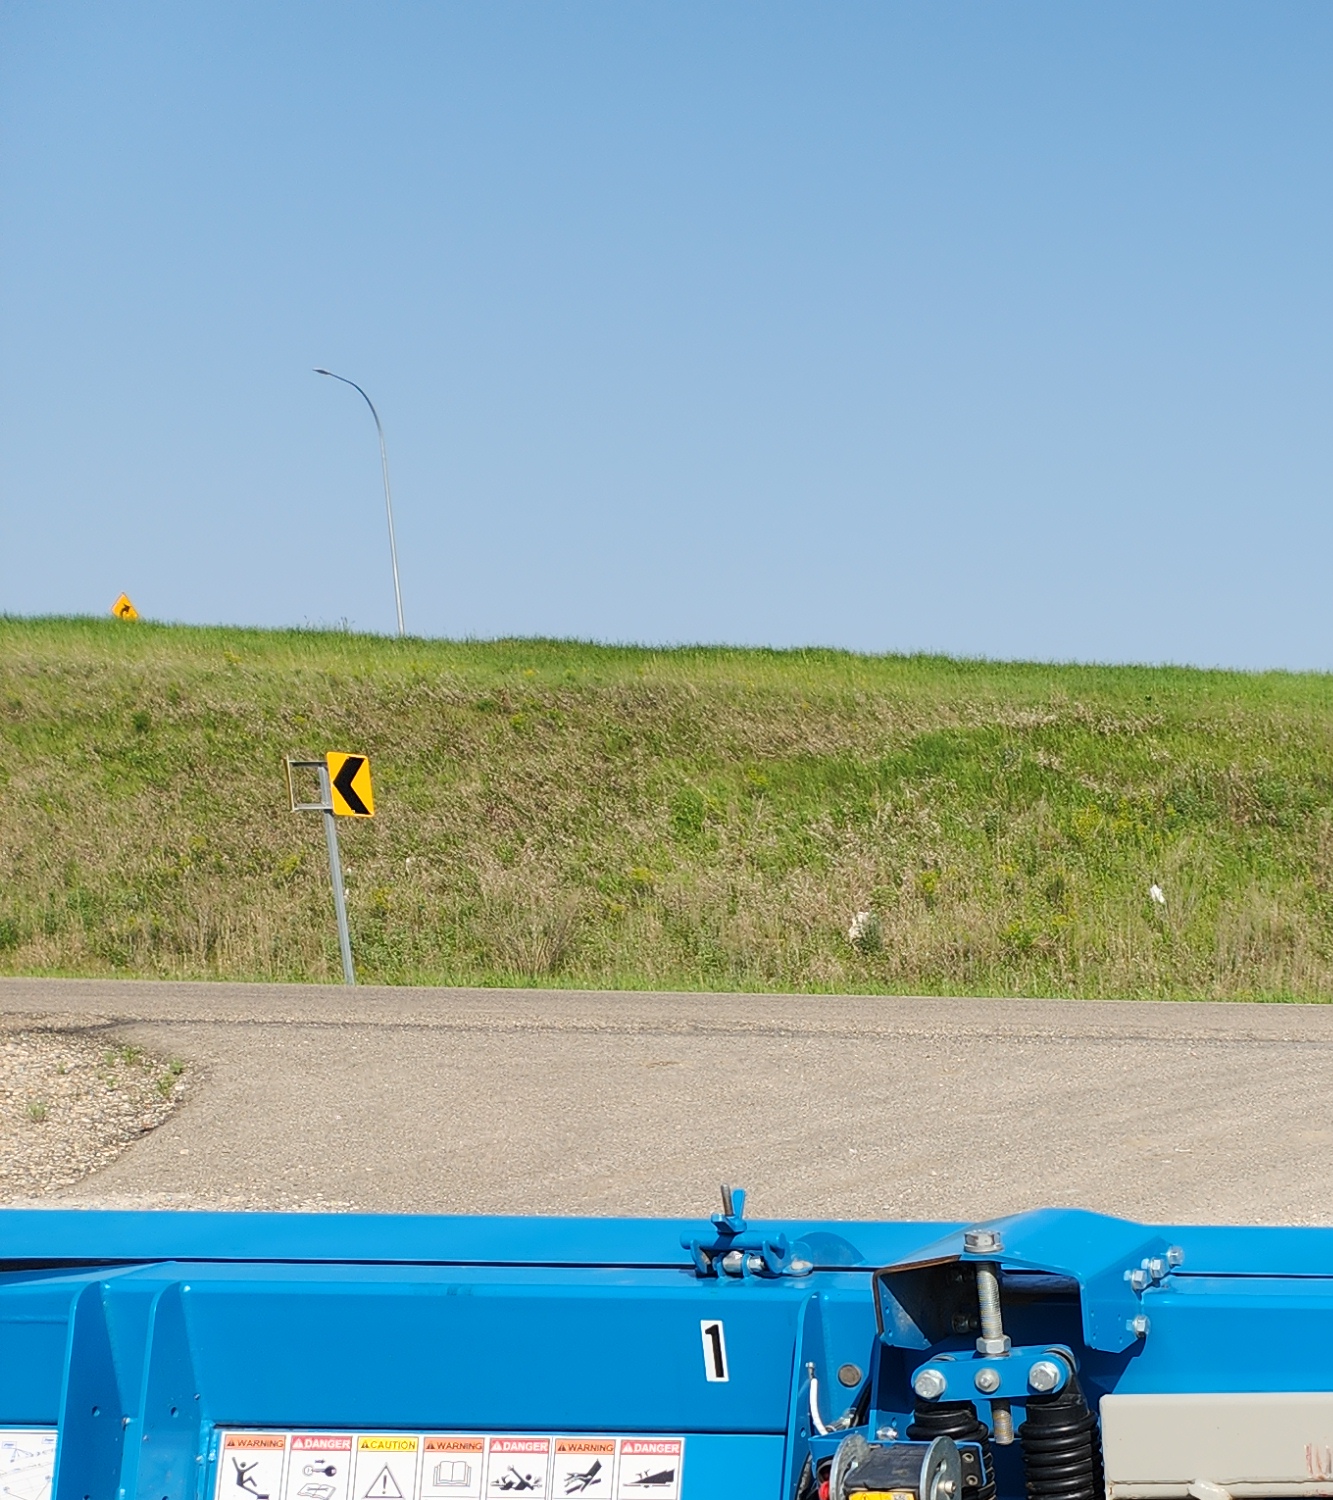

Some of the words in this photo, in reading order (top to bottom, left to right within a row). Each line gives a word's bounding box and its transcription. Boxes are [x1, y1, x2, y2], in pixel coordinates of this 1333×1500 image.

[705, 1324, 724, 1378] 1
[237, 1439, 284, 1448] WARNING
[304, 1438, 351, 1449] DANGER
[370, 1440, 416, 1449] CAUTION
[437, 1441, 483, 1450] WARNING
[503, 1441, 548, 1451] DANGER
[568, 1443, 614, 1452] WARNING
[633, 1443, 679, 1453] DANGER
